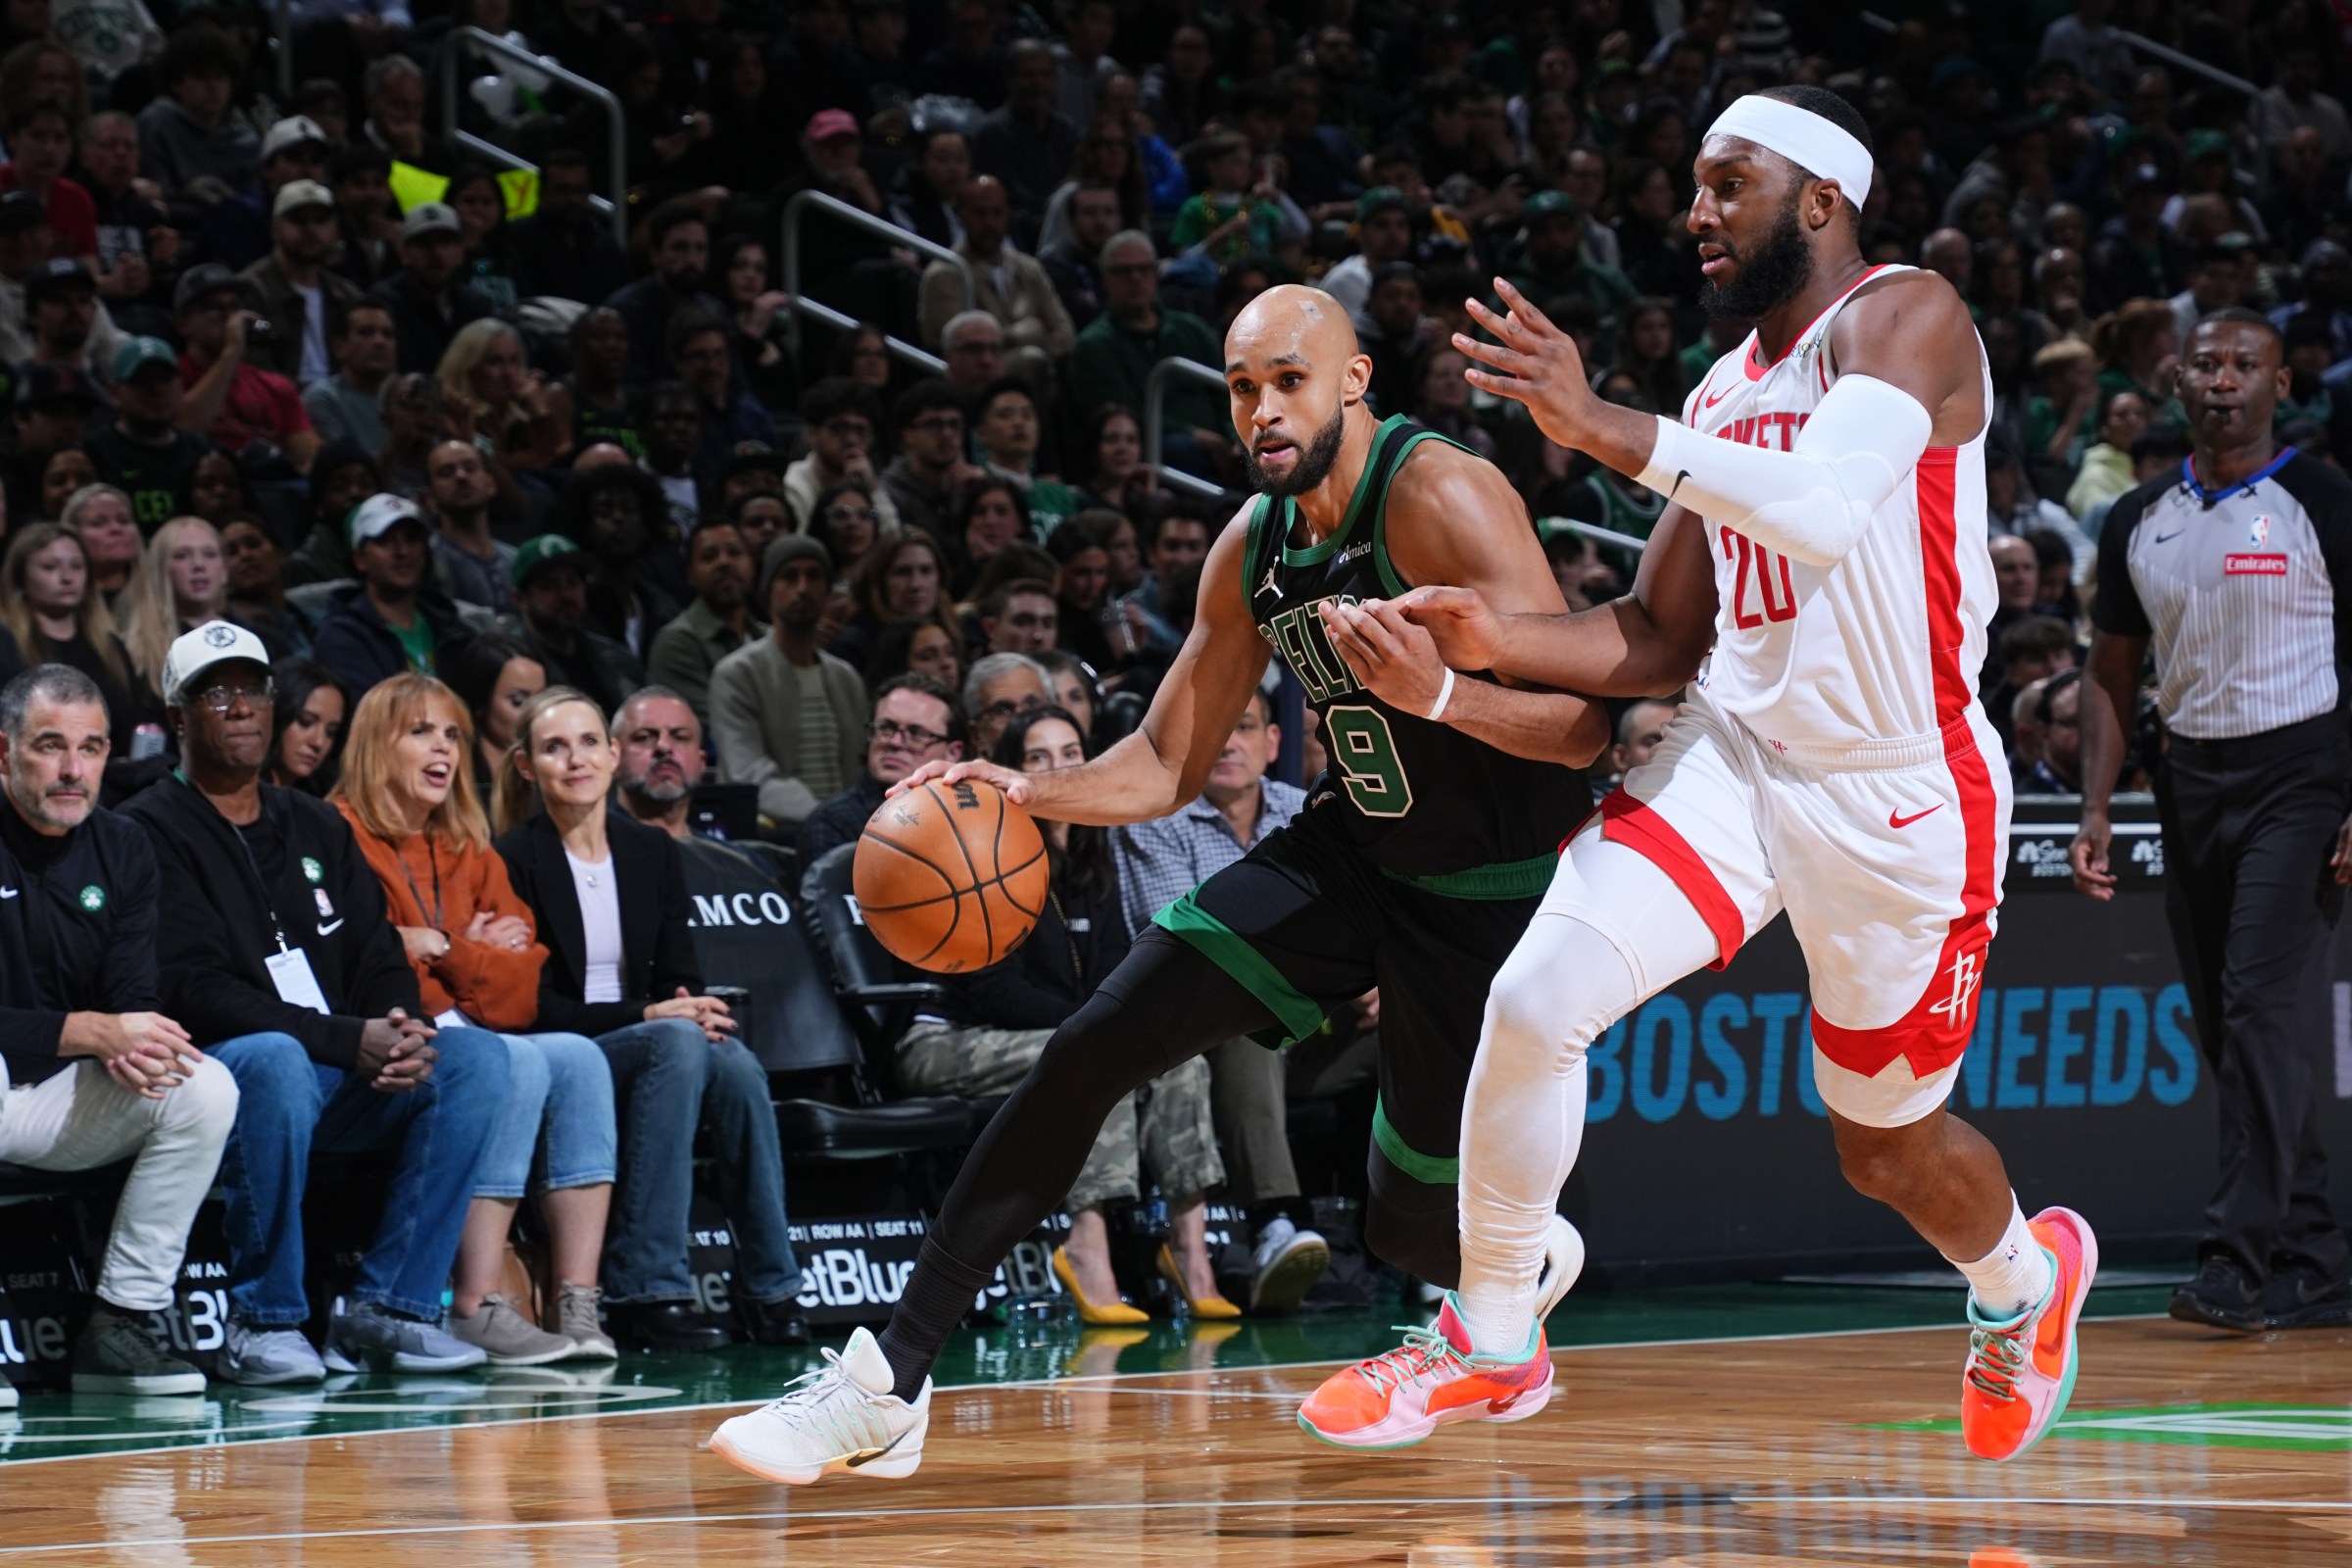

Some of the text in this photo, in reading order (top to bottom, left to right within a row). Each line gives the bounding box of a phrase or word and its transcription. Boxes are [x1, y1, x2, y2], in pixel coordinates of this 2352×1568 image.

[1339, 541, 1372, 564] Amica
[2226, 557, 2285, 571] Emirates
[1720, 525, 1797, 630] 20
[1325, 706, 1413, 817] 9
[687, 891, 791, 927] MCO
[1584, 991, 1827, 1123] BOST
[811, 1224, 844, 1240] ROW
[846, 1223, 865, 1238] AA
[875, 1221, 907, 1236] SEAT
[909, 1220, 924, 1235] 11
[9, 1274, 46, 1289] SEAT
[795, 1248, 916, 1308] etBlu
